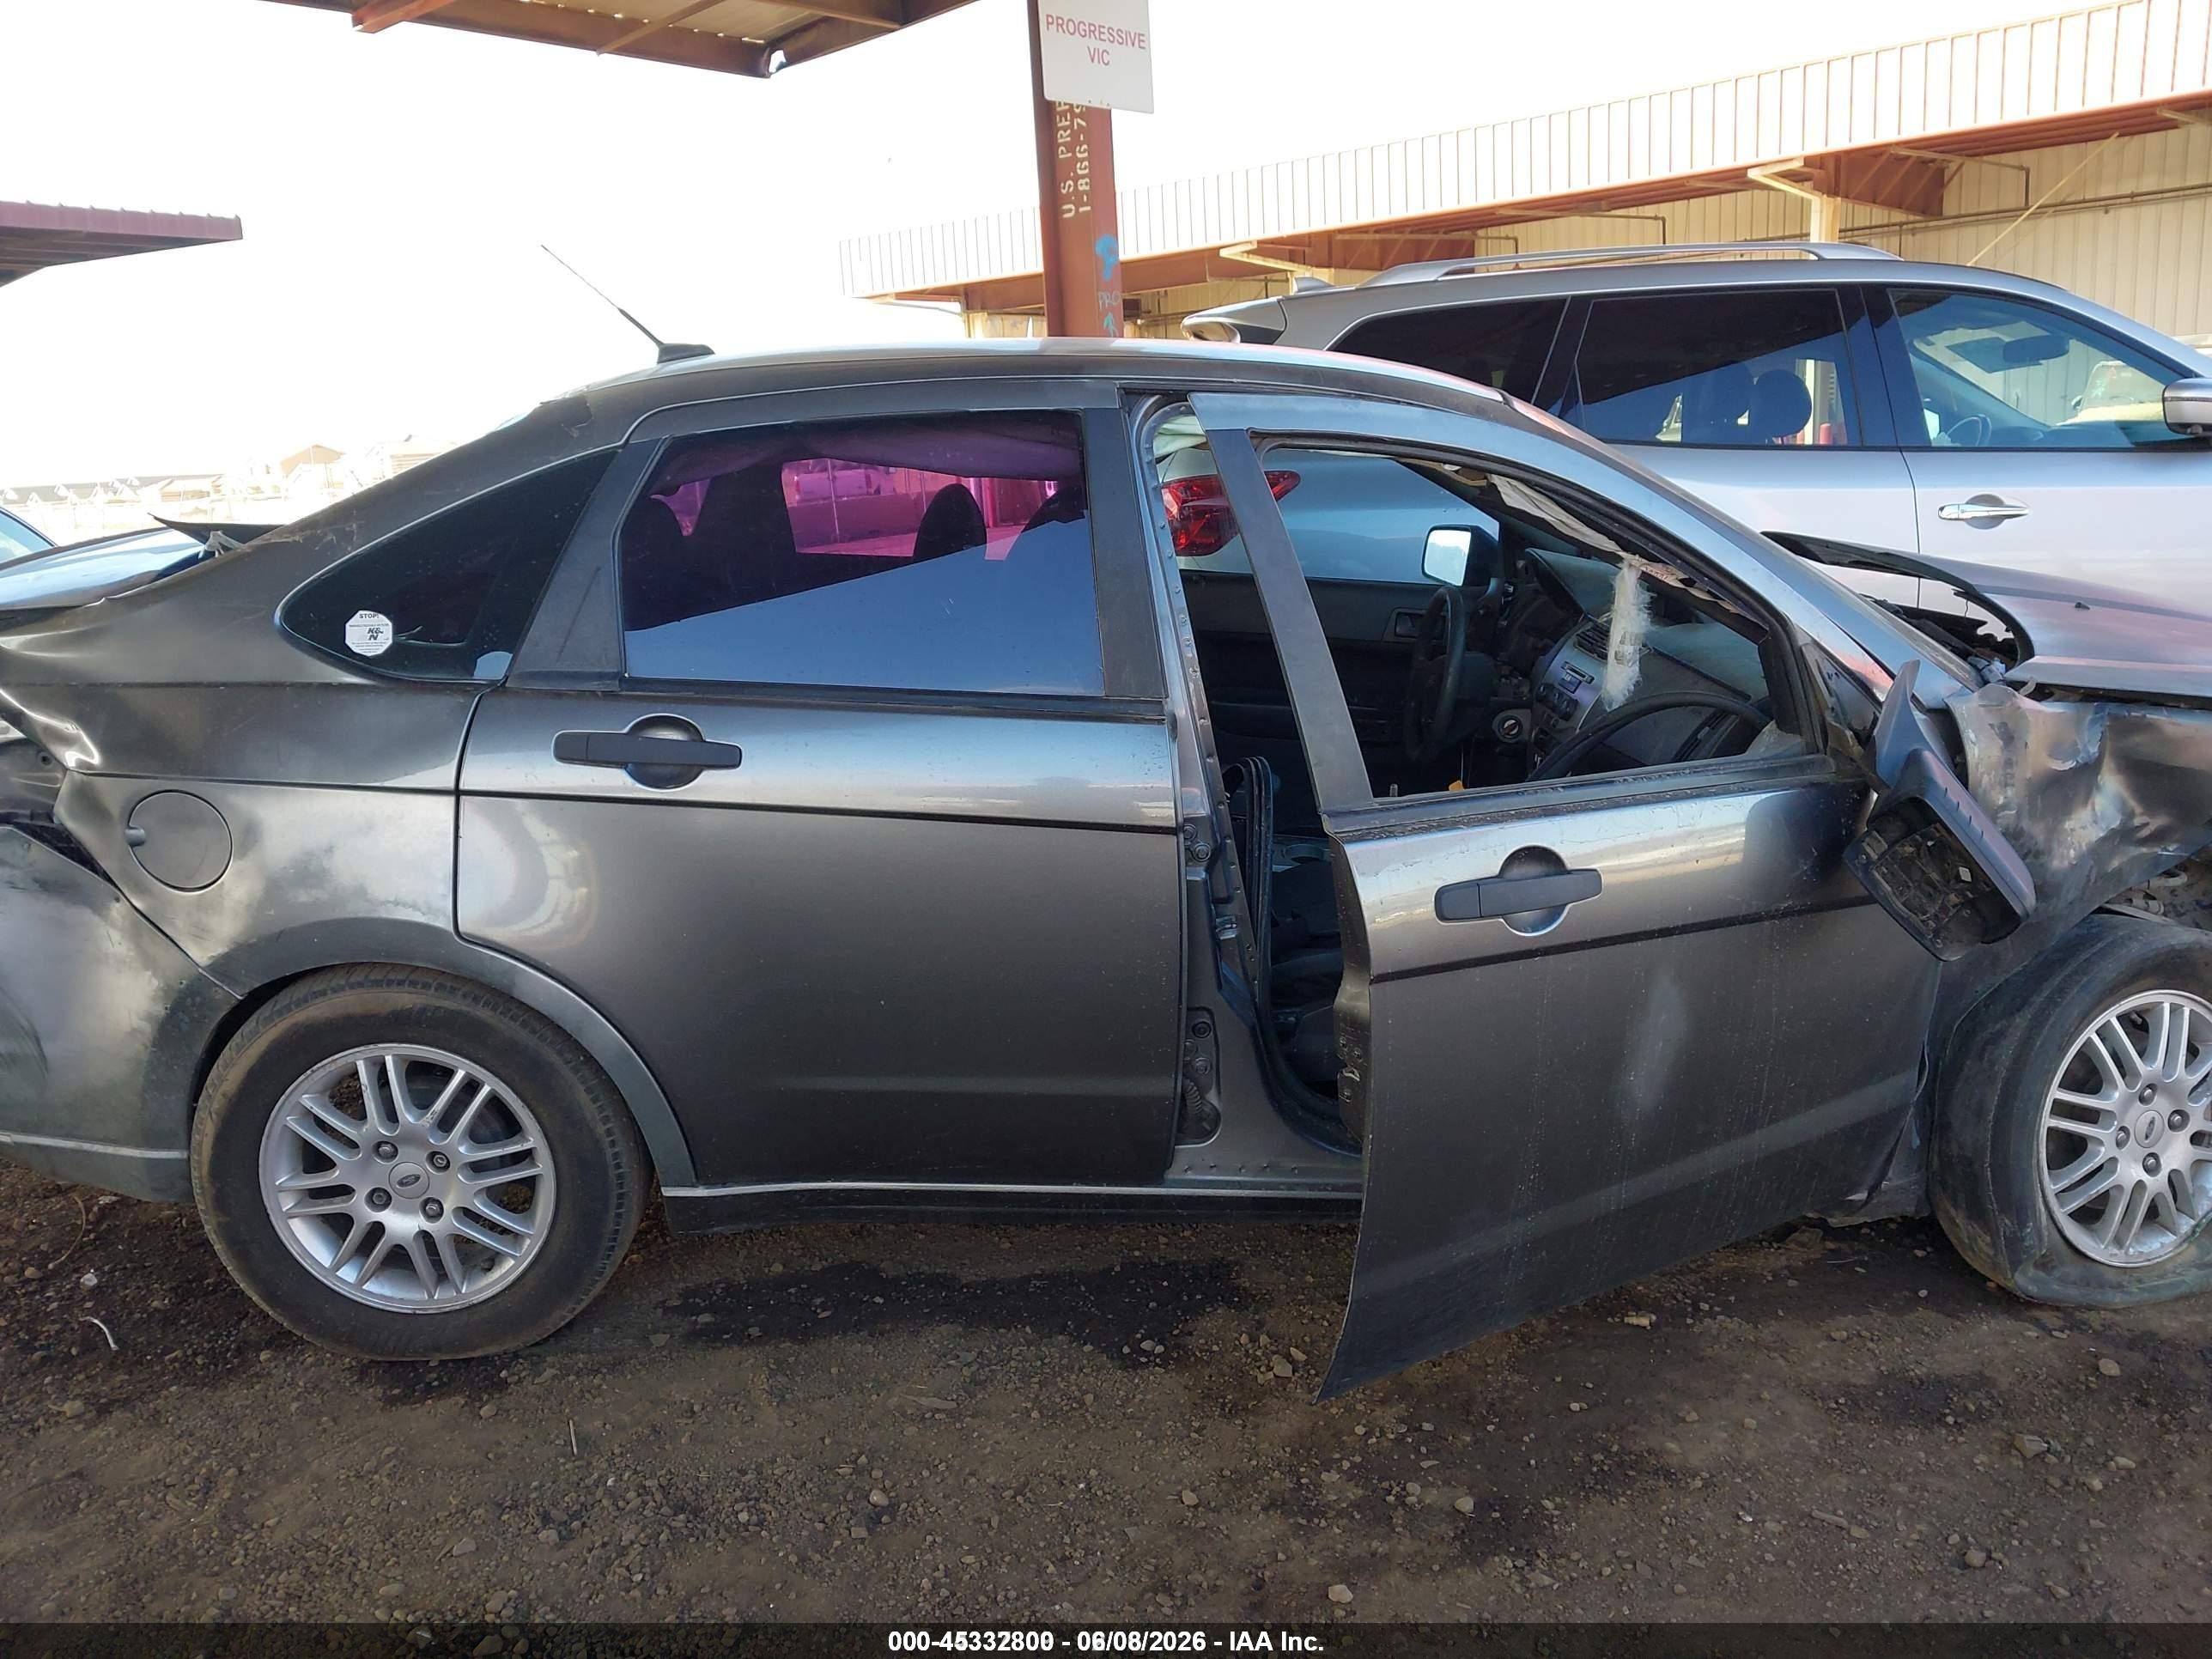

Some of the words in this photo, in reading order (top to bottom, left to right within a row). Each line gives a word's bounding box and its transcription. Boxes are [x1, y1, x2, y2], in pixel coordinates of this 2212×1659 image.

[1046, 14, 1146, 50] PROGRESSIVE
[1087, 46, 1110, 66] VIC
[1060, 171, 1076, 218] U.S.
